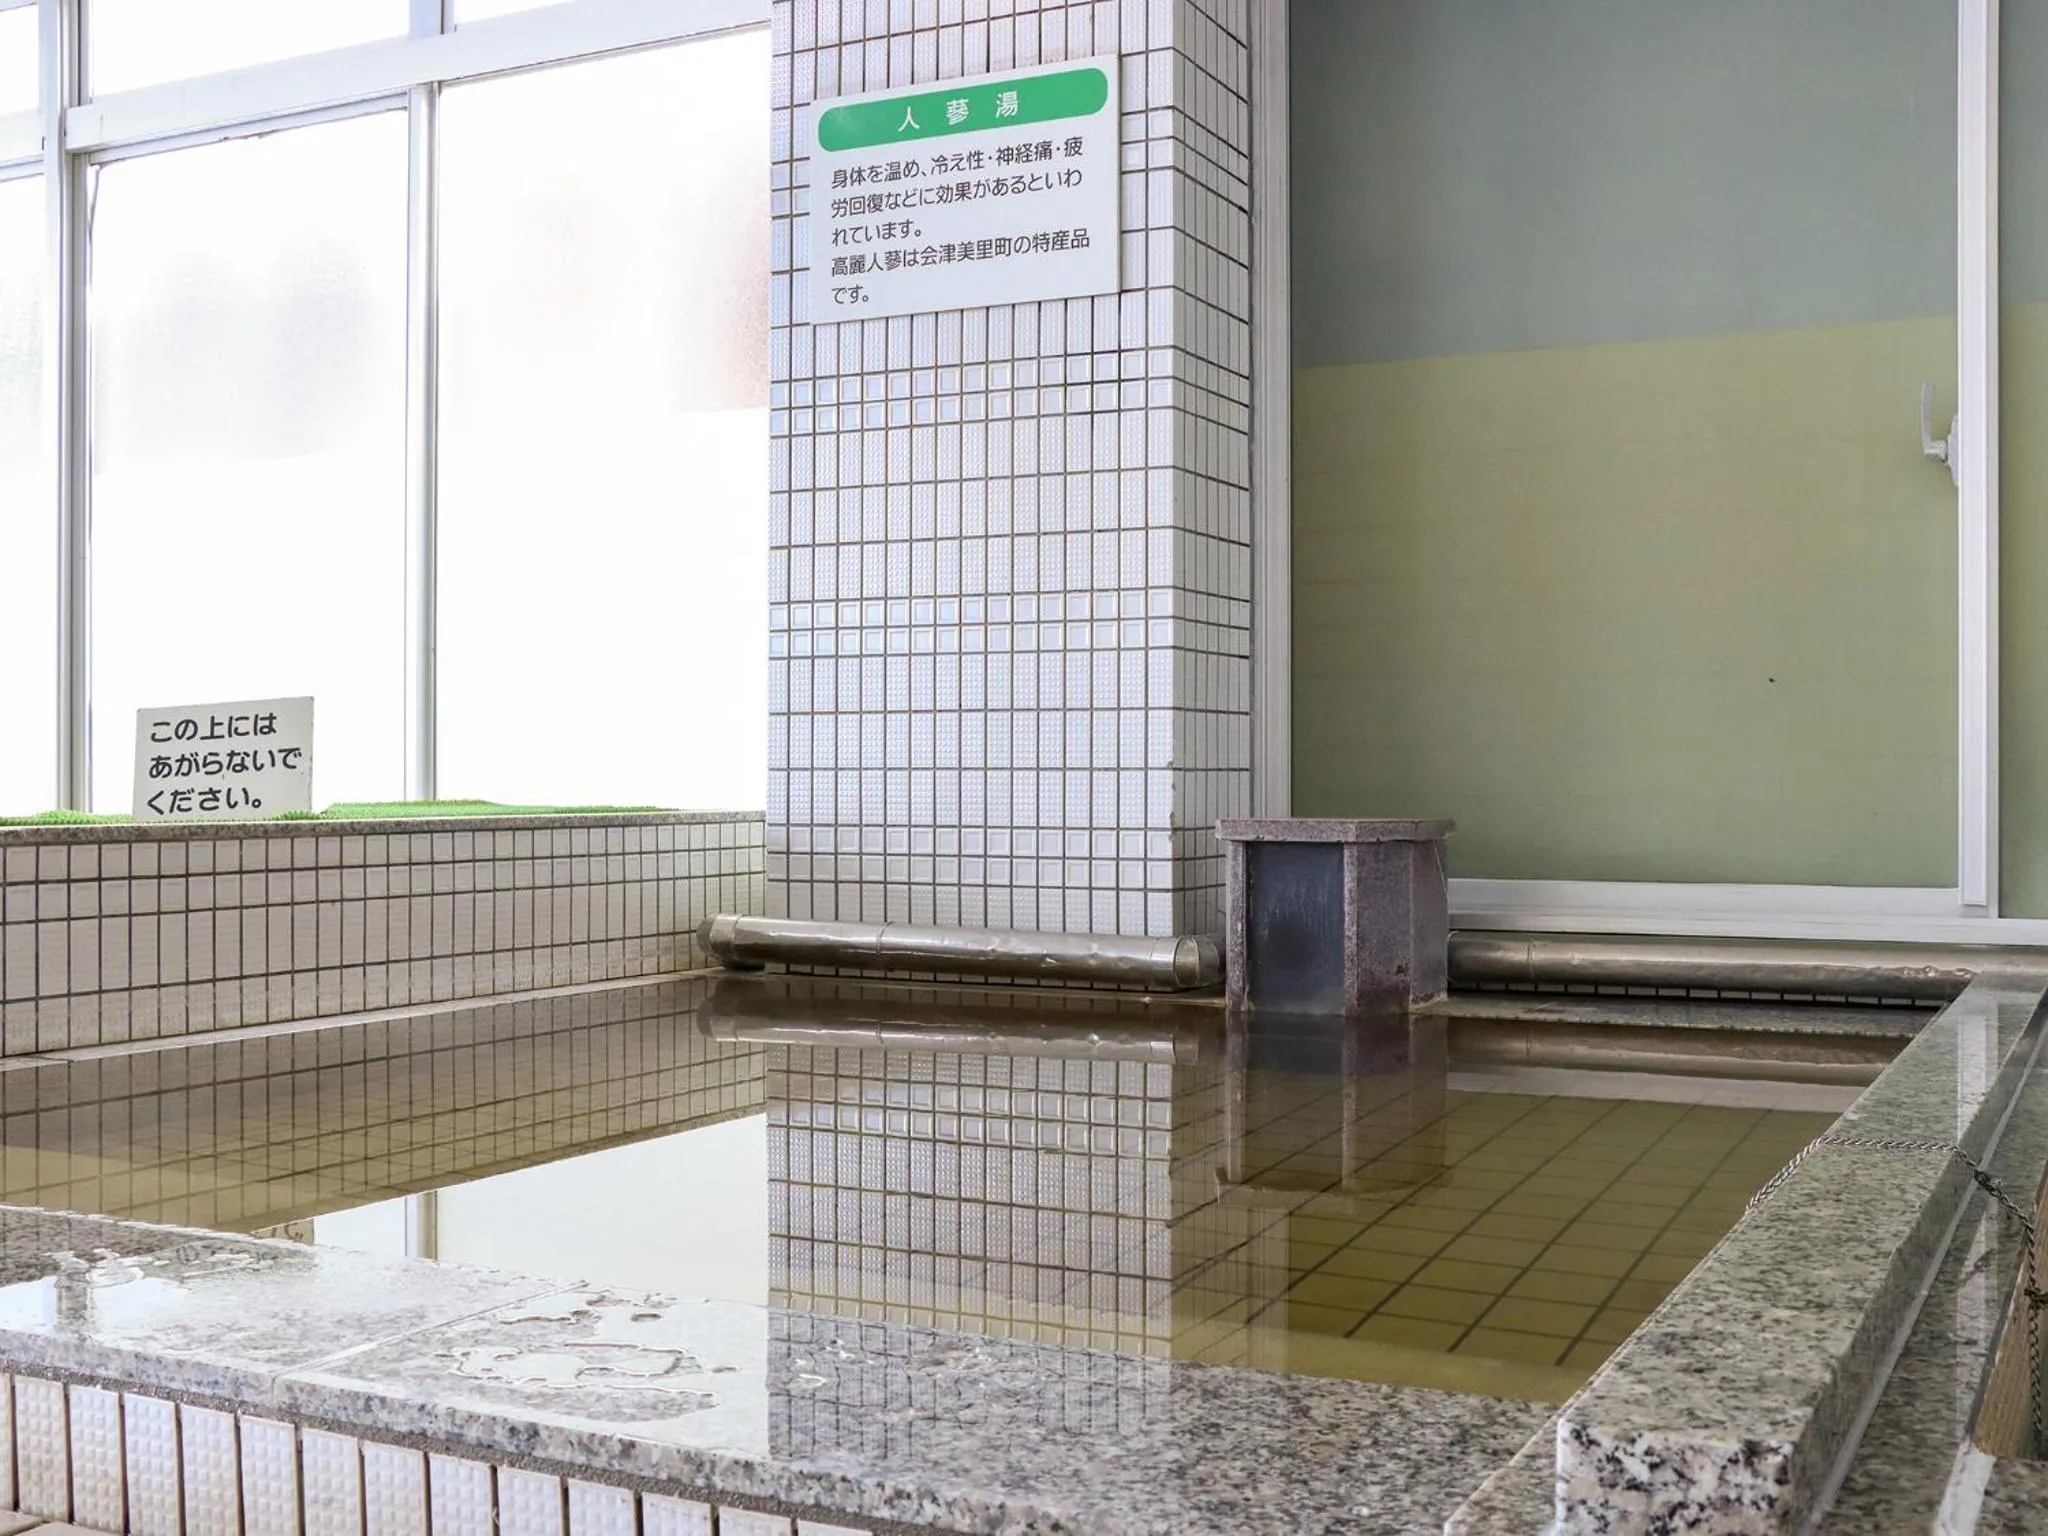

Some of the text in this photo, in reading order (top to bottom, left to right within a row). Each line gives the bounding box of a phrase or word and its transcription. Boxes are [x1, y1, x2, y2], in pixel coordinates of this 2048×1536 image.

[831, 136, 1083, 189] 身体を温め、冷え性・神経痛・疲
[831, 168, 1082, 219] 労回復などに効果があるといわ
[832, 219, 923, 247] れています。
[832, 284, 869, 305] です。
[150, 713, 277, 743] この上には
[148, 747, 302, 779] あがらないで
[147, 787, 262, 816] ください。
